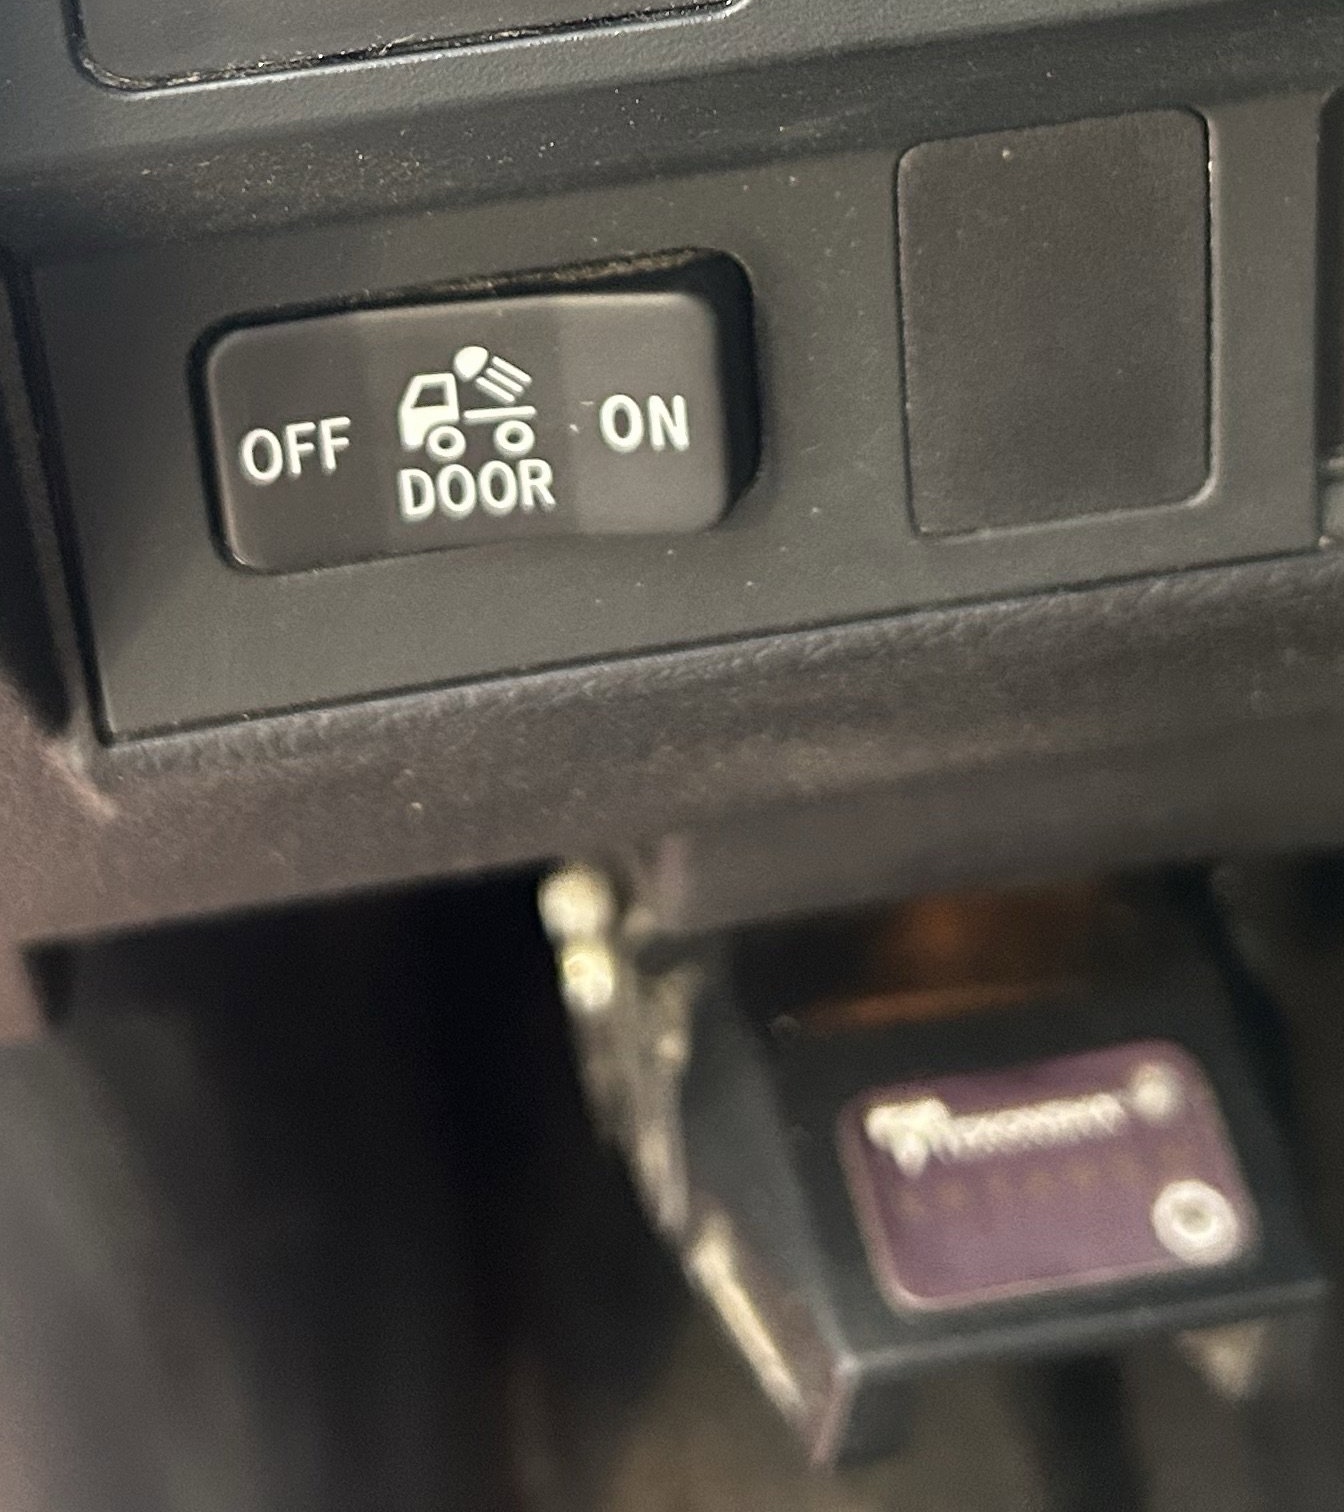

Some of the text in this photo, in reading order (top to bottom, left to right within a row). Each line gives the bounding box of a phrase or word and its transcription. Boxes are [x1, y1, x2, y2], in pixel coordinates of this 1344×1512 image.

[240, 393, 690, 484] OFF ON
[398, 458, 556, 522] DOOR
